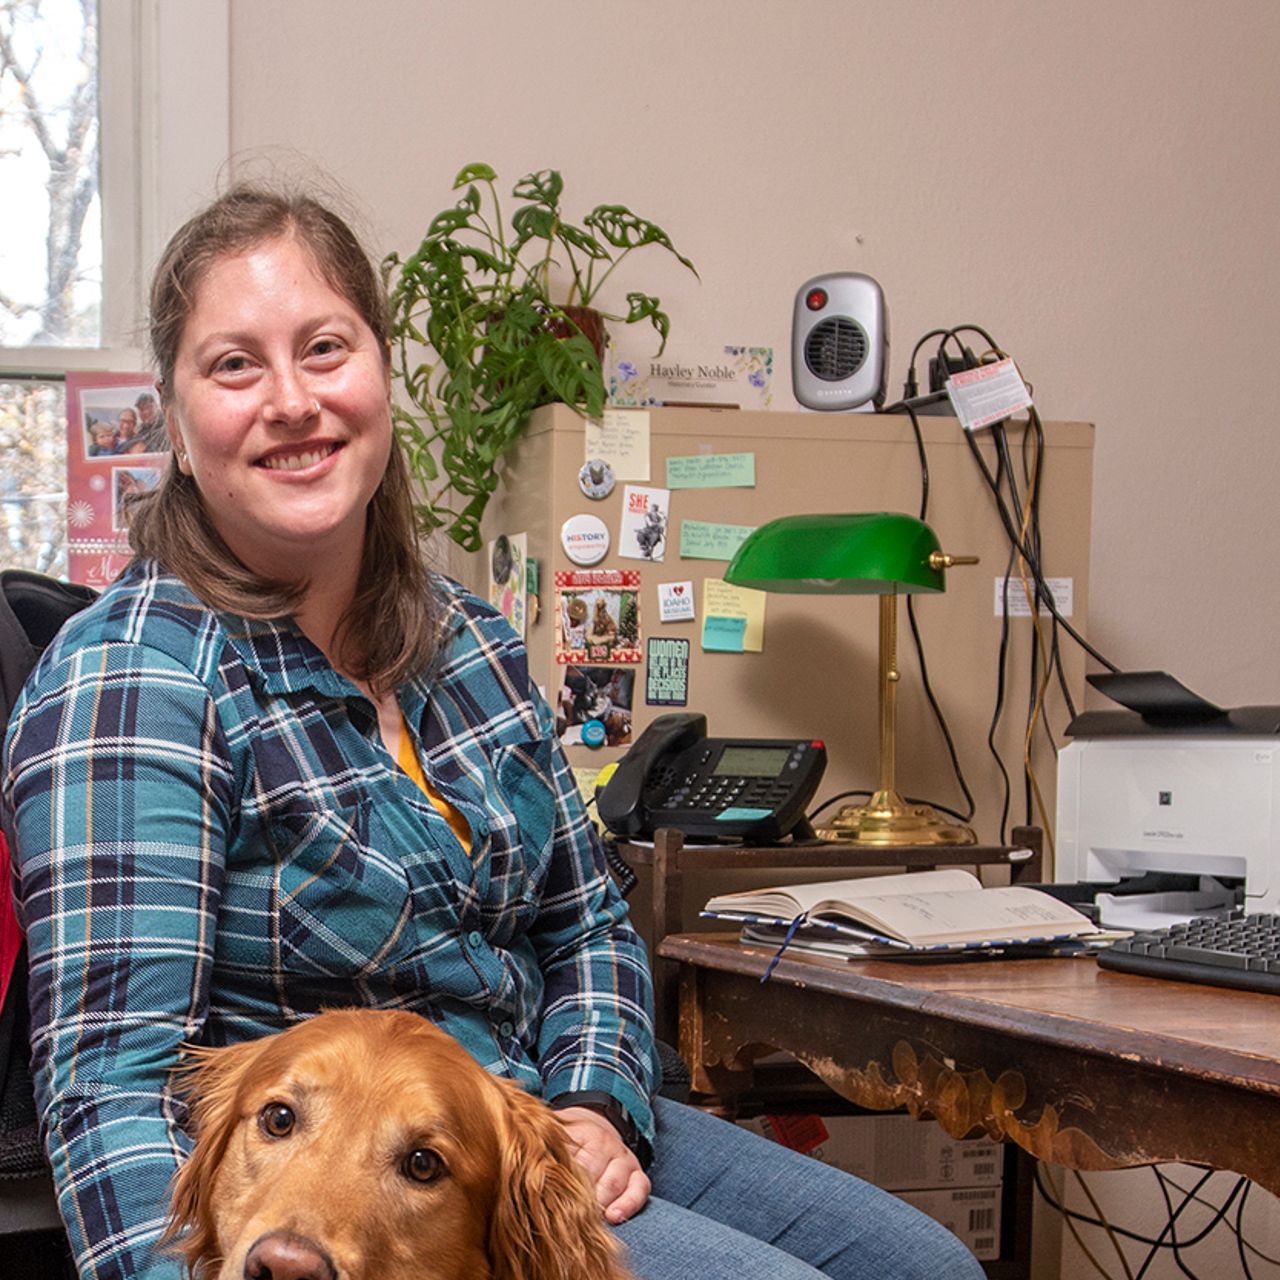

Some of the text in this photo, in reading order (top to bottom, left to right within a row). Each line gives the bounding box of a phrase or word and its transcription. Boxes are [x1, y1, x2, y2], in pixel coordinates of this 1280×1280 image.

[650, 363, 736, 380] Hayley Noble
[629, 493, 648, 509] SHE
